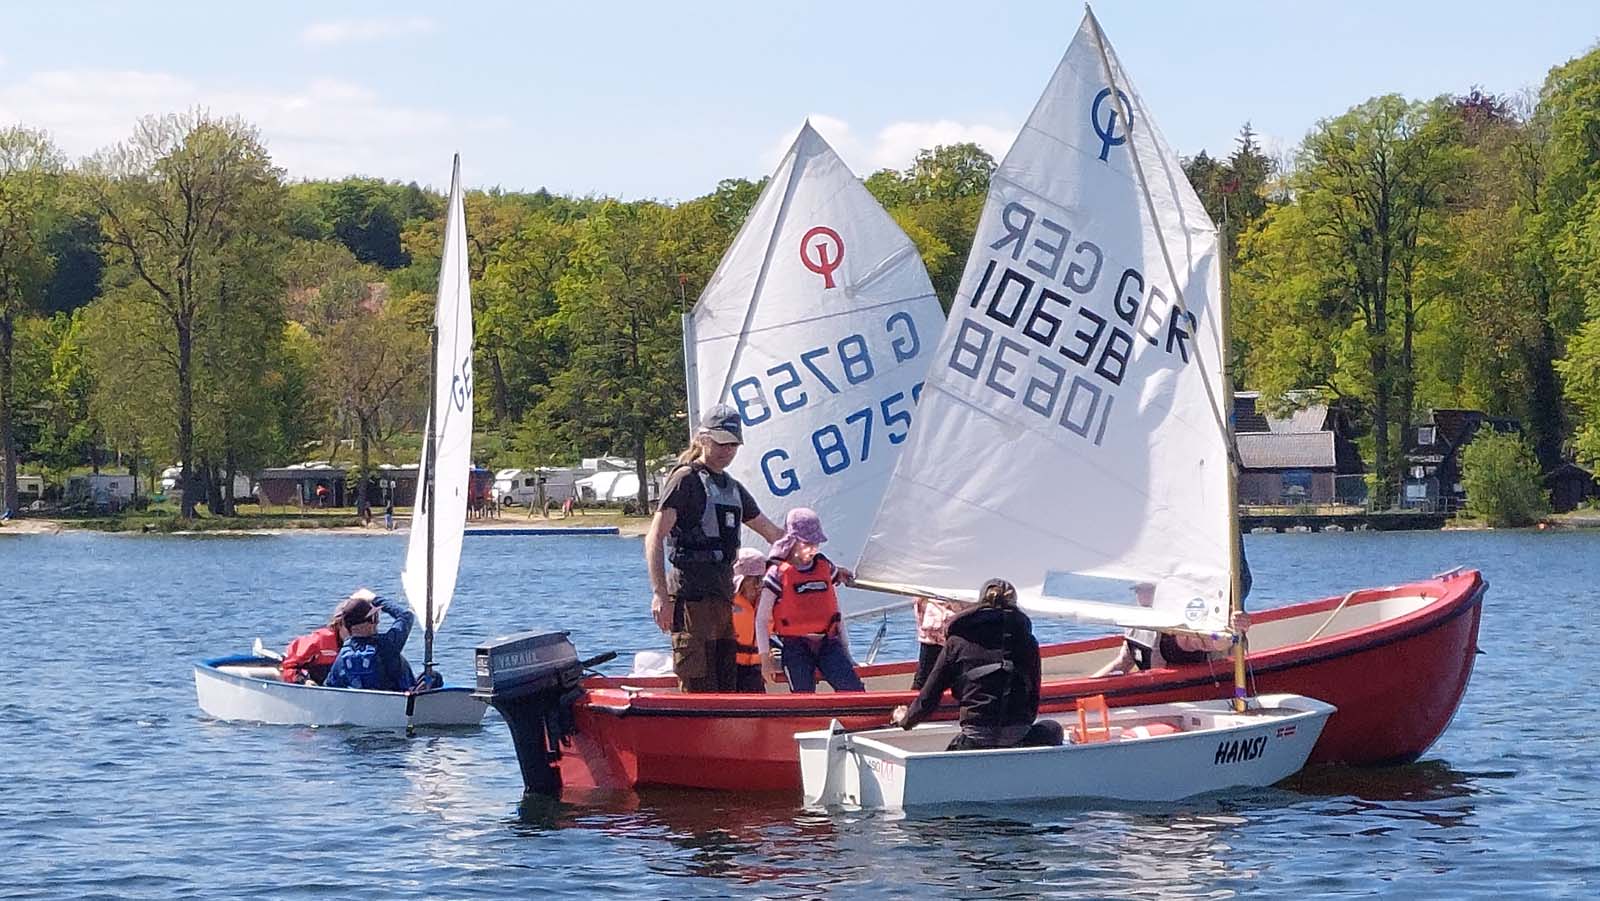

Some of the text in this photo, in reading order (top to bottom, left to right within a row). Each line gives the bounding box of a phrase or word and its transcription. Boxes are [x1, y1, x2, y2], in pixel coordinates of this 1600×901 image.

[969, 259, 1135, 386] 10638
[1113, 268, 1198, 364] GER
[452, 344, 474, 413] GE
[760, 381, 926, 497] G 875
[1214, 735, 1268, 765] HANSI
